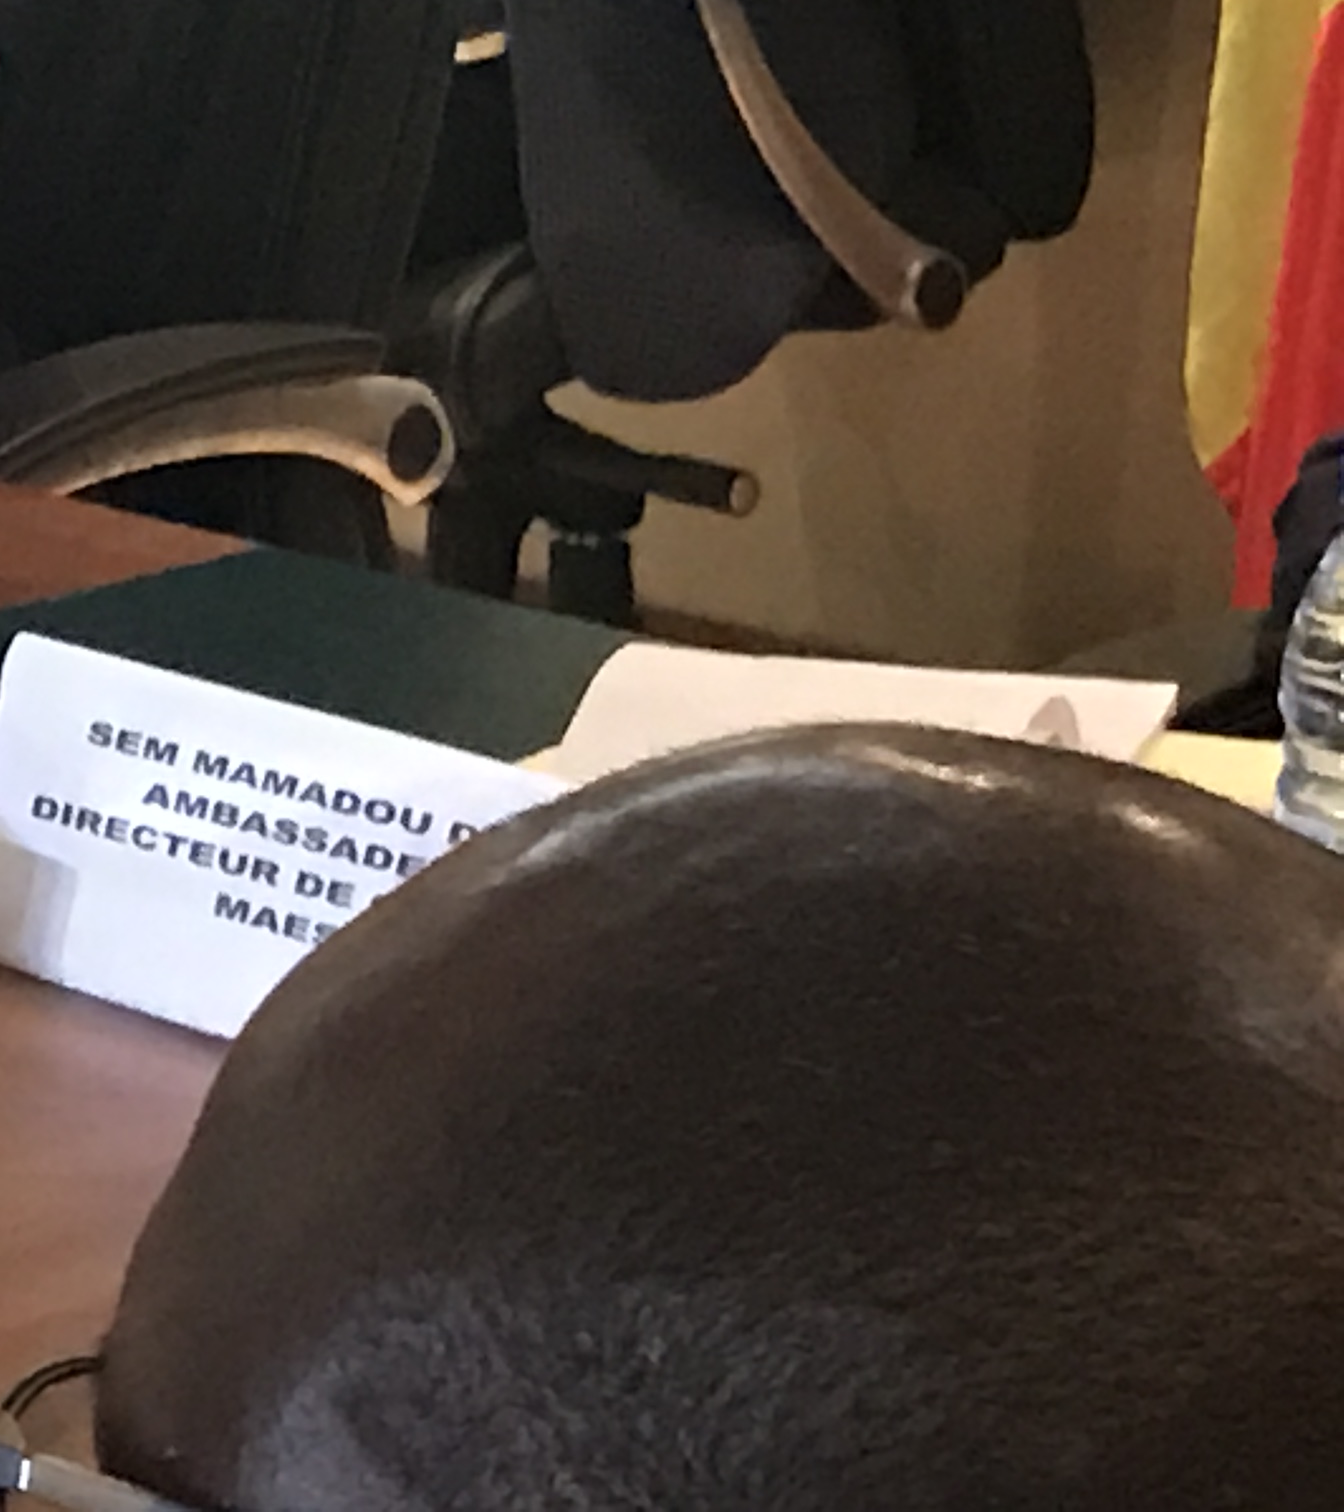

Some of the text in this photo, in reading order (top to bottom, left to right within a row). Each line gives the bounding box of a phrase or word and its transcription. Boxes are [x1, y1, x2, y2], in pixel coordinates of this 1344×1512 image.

[86, 720, 180, 767] SEM
[191, 749, 434, 836] MAMADOU
[31, 795, 356, 908] DIRECTEUR DE
[142, 784, 427, 878] AMBASSADE
[214, 892, 338, 944] MAES
